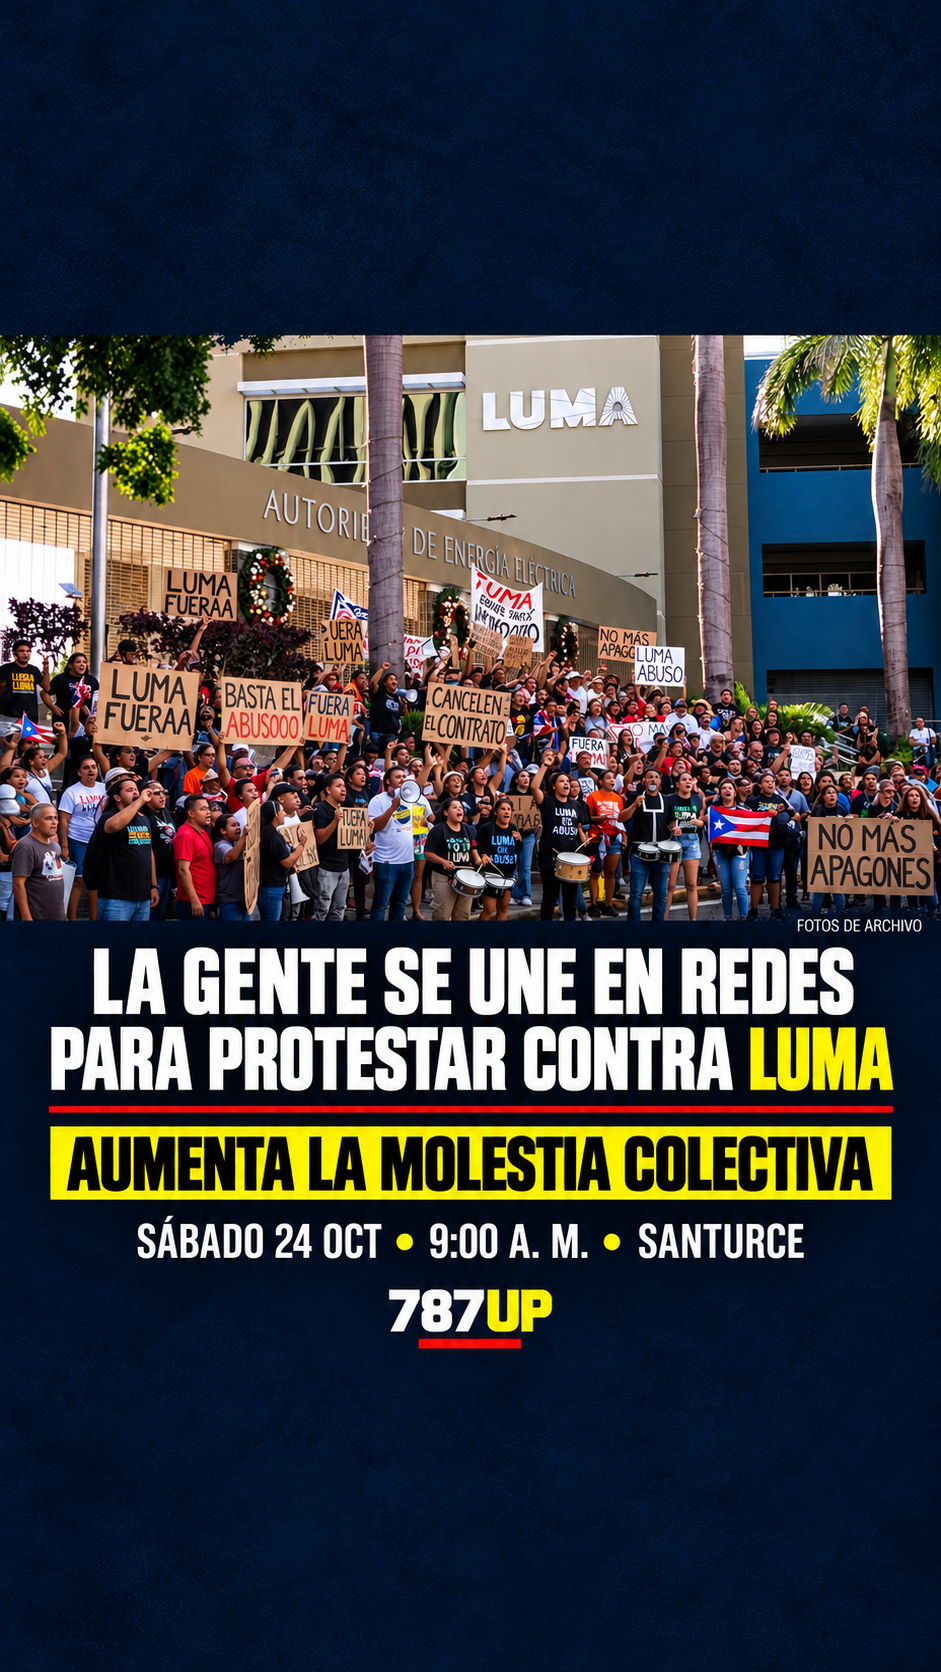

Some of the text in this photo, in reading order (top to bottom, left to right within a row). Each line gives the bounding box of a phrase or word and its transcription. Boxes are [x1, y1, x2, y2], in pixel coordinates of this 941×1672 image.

[482, 386, 638, 431] LUMA
[413, 527, 437, 560] DE
[444, 536, 510, 578] ENERGÍA
[514, 556, 576, 598] ELÉCTRICA
[167, 570, 232, 597] LUMA
[165, 594, 233, 619] FUERAA
[600, 628, 649, 646] NO MÁS
[324, 642, 364, 662] LUMA
[636, 646, 673, 664] LUMA
[111, 668, 187, 705] LUMA
[637, 664, 683, 683] ABUSO
[225, 682, 300, 711] BASTA EL
[308, 693, 350, 716] FUERA
[432, 687, 503, 716] CANCELEN
[104, 701, 191, 736] FUERAA
[225, 711, 299, 739] ABUSOOO
[308, 716, 348, 740] LUMA
[424, 714, 506, 745] EL CONTRATO
[571, 738, 604, 751] FUERA
[819, 821, 917, 853] NO MÁS
[809, 855, 931, 890] APAGONES
